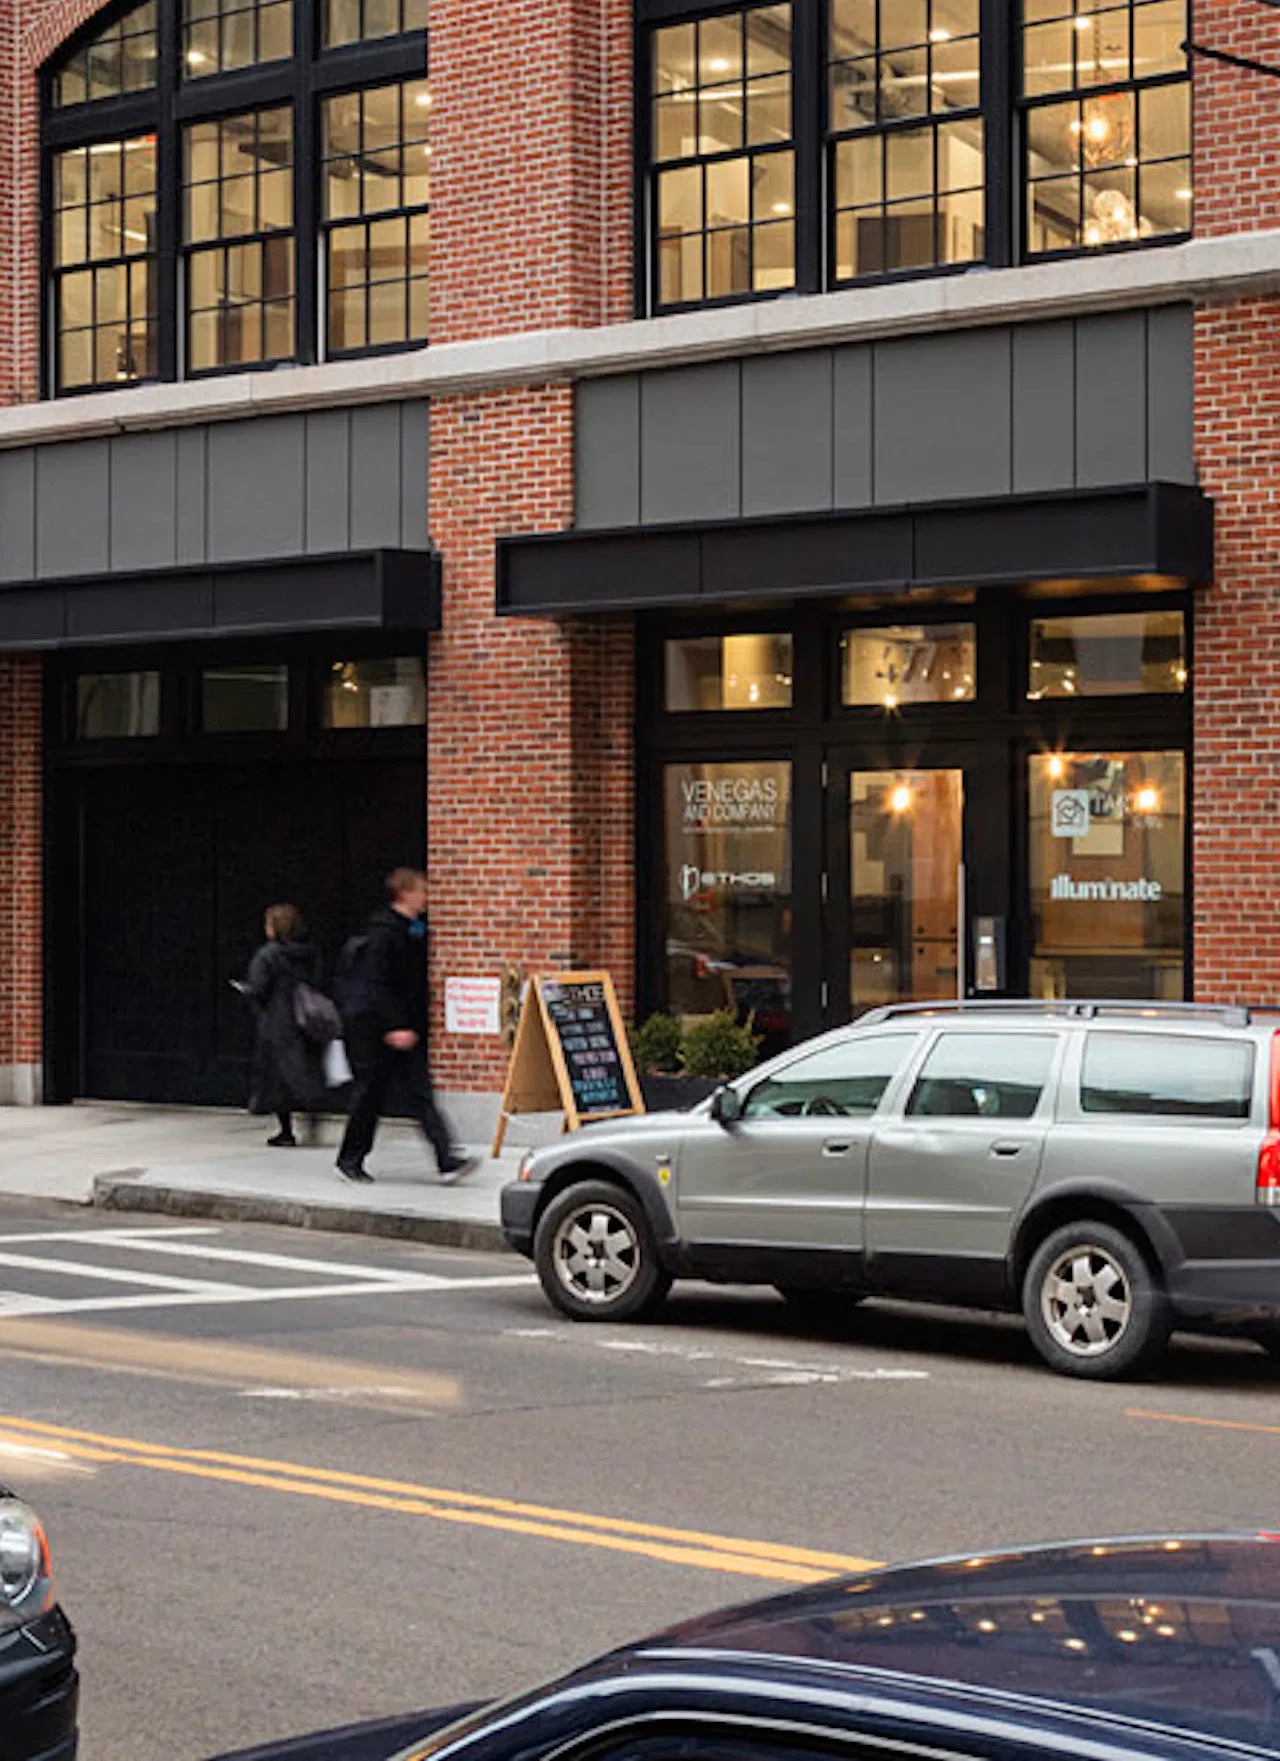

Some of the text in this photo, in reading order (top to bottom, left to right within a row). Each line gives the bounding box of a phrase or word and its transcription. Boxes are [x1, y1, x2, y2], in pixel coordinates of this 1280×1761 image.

[680, 778, 778, 804] VENEGAS
[683, 802, 778, 821] AND COMPANY
[1049, 873, 1163, 901] illuminate
